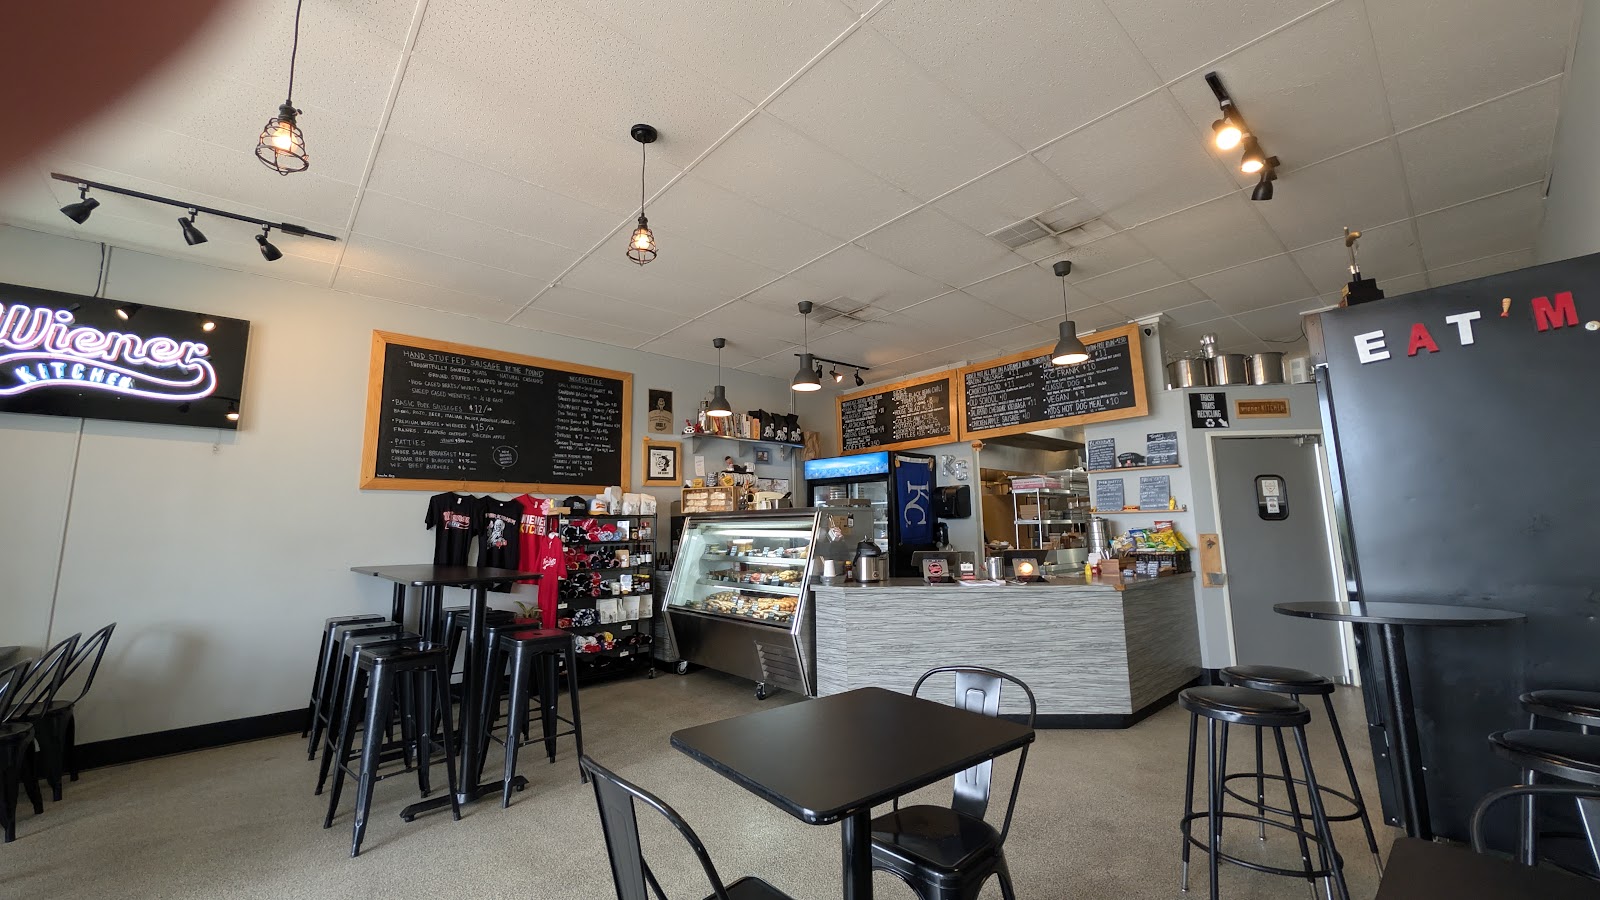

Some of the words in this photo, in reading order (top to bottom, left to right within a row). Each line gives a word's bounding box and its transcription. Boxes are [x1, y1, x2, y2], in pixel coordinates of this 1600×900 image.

[0, 303, 209, 365] Wiener
[1095, 349, 1107, 357] $11
[403, 350, 425, 360] HAND
[428, 354, 466, 365] STUFFED
[470, 360, 500, 370] SAUSAGE
[526, 368, 544, 377] POUND
[409, 361, 448, 371] THOUGHTFULLY
[15, 361, 134, 389] KITCHEN
[500, 373, 520, 381] NATURAL
[982, 371, 1005, 382] SAUSAGE
[1043, 371, 1055, 380] KC
[1056, 366, 1080, 378] FRANK
[1082, 363, 1096, 371] $10
[569, 376, 602, 385] NECESSITIES
[1044, 381, 1064, 391] CLASSIC
[1067, 379, 1080, 387] DOG
[968, 385, 987, 395] CHORIZO
[1004, 379, 1014, 388] $11
[431, 389, 446, 397] CASED
[448, 392, 470, 400] WIENERS
[979, 394, 998, 405] SCHOOL
[1046, 393, 1070, 404] VEGAN
[395, 398, 414, 407] BASIC
[433, 403, 462, 412] SAUSAGES
[989, 405, 1006, 414] CHEDDAR
[1046, 406, 1060, 415] KIDS
[1062, 404, 1073, 413] HOT
[1076, 402, 1088, 410] DOG
[1089, 400, 1104, 409] MEAL
[1106, 397, 1120, 405] $10
[1197, 410, 1221, 418] RECYCLING
[972, 420, 988, 428] CHICKEN
[988, 417, 1000, 425] APPLE
[1002, 414, 1020, 423] SAUSAGE
[896, 432, 916, 440] BOTTLES
[395, 438, 425, 446] PATTIES
[941, 454, 968, 480] KC
[904, 480, 929, 526] KC
